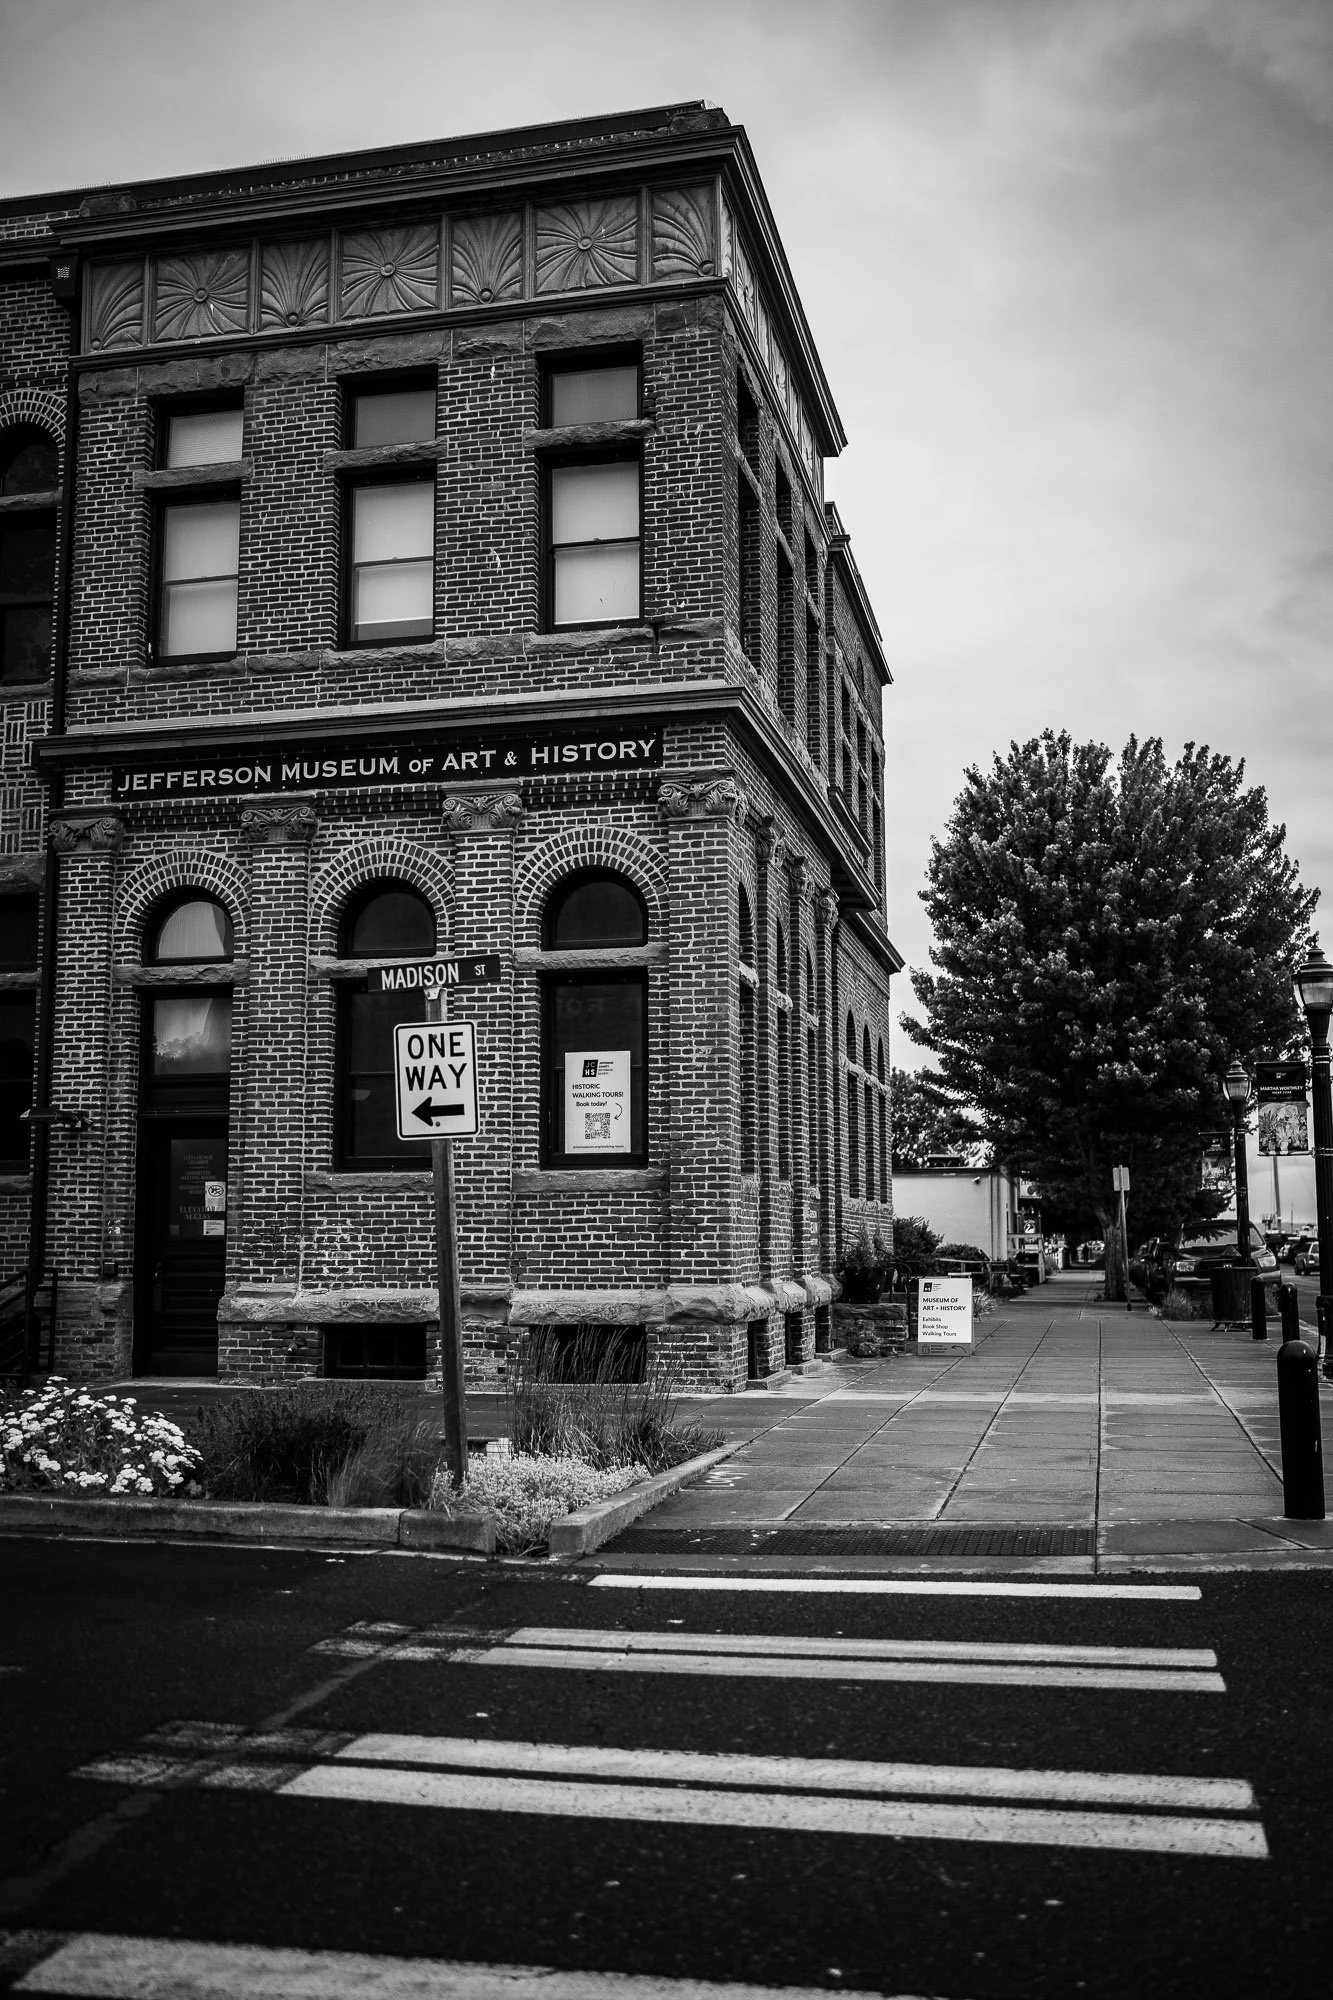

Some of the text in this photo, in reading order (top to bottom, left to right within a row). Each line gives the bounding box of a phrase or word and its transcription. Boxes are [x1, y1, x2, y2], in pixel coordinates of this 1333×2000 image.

[117, 766, 271, 793] JEFFERSON
[282, 756, 399, 781] MUSEUM
[442, 750, 496, 771] ART
[504, 751, 517, 766] &
[530, 738, 657, 765] HISTORY
[381, 962, 486, 990] MADISON ST
[407, 1032, 465, 1060] ONE
[405, 1062, 468, 1091] WAY
